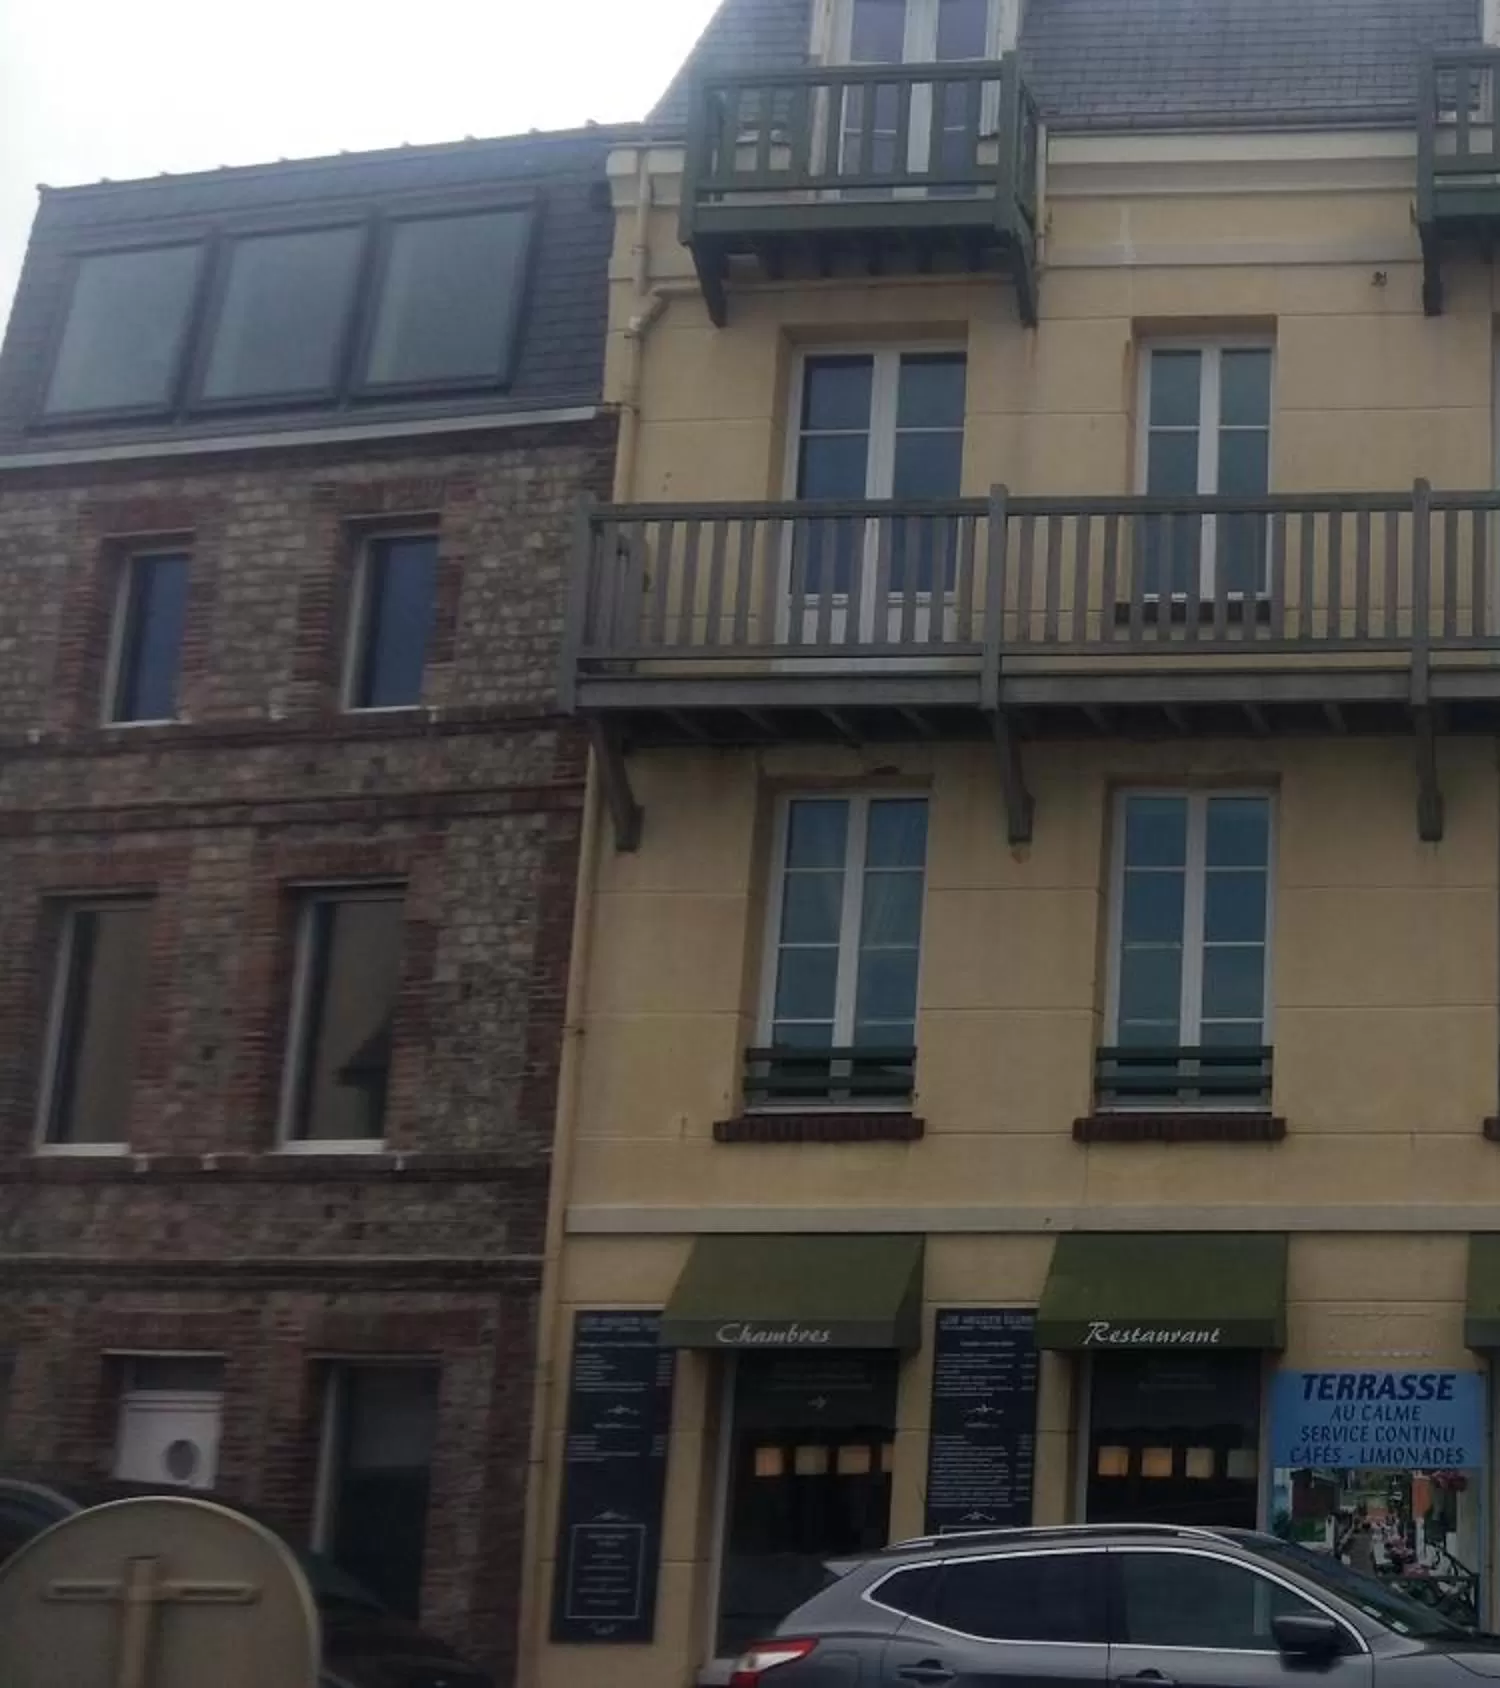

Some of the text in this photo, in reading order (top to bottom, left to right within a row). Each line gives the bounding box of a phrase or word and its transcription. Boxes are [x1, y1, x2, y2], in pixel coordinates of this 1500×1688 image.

[716, 1322, 831, 1343] Chambres
[1083, 1321, 1220, 1344] Restaurant
[1302, 1373, 1456, 1401] TERRASSE
[1330, 1403, 1422, 1423] AU CALME
[1301, 1425, 1456, 1443] SERVICE CONTINU
[1289, 1443, 1344, 1464] CAFÉS
[1359, 1446, 1465, 1464] LIMONADES
